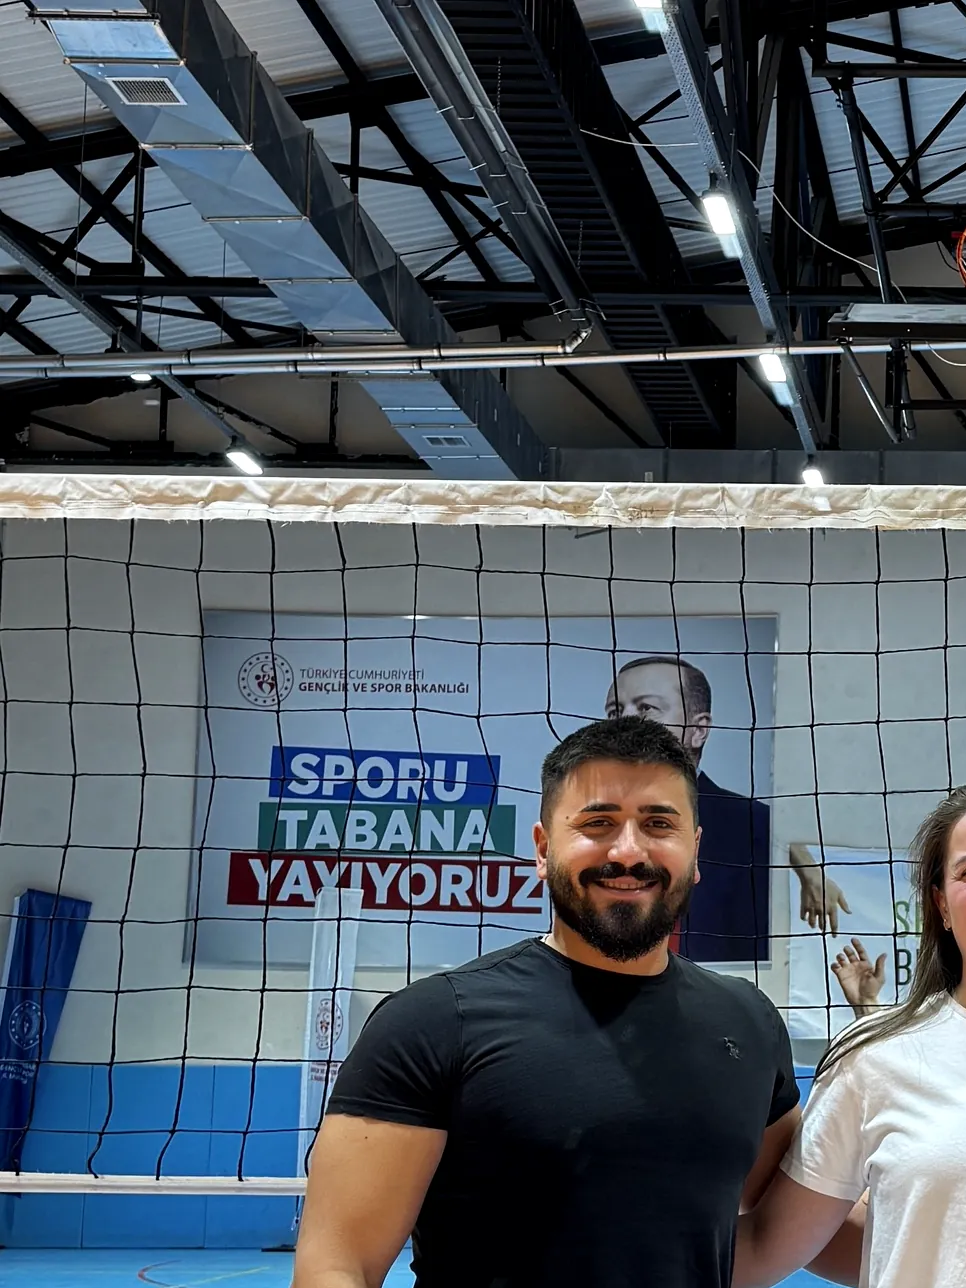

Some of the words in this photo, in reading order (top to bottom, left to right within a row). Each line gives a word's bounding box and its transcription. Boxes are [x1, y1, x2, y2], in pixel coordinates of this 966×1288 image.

[352, 683, 368, 693] VE
[370, 683, 402, 693] SPOR
[287, 753, 468, 801] SPORU
[278, 809, 495, 851] TABANA
